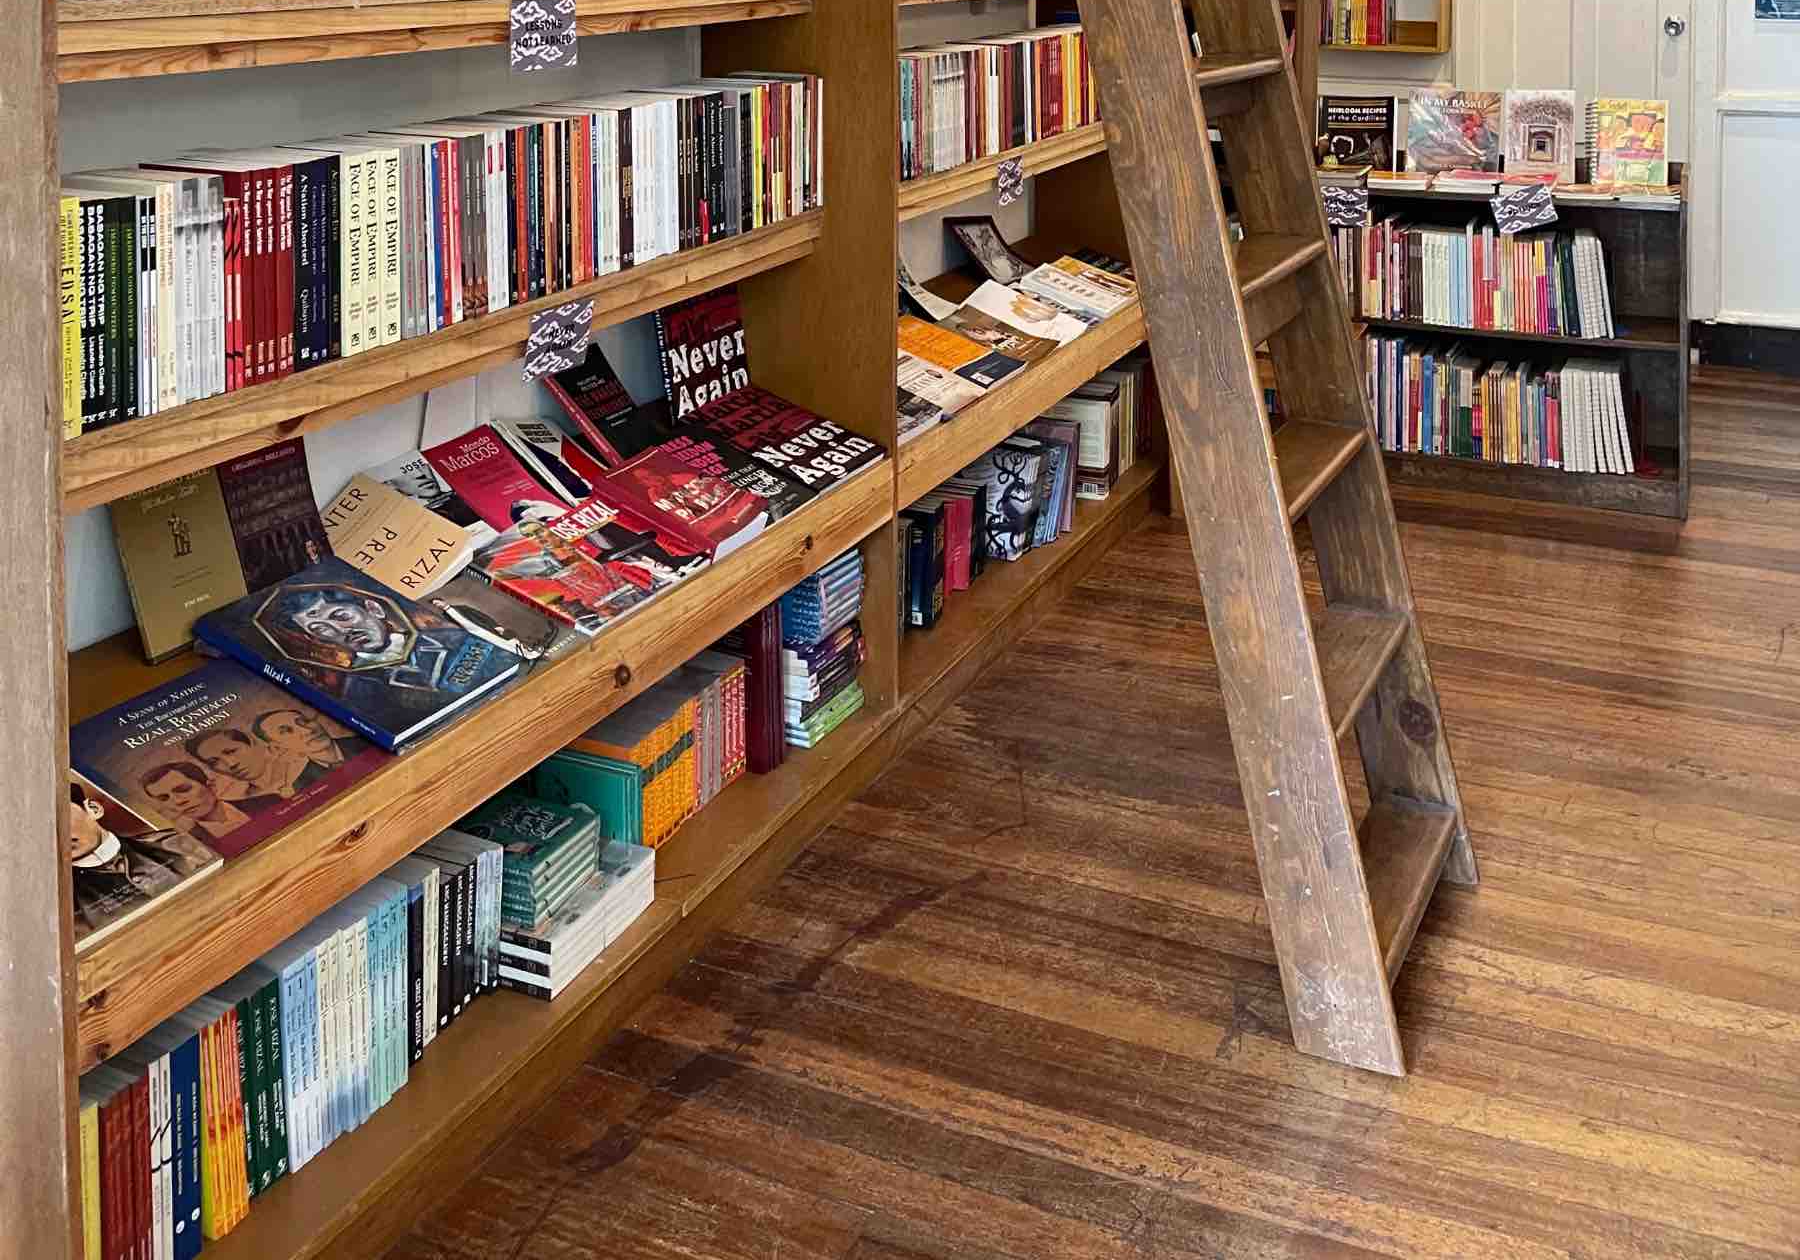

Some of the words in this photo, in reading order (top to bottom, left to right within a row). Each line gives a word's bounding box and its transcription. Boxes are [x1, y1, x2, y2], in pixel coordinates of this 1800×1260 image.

[525, 19, 562, 32] LESSONS
[349, 164, 361, 199] FACE
[366, 160, 377, 196] FACE
[385, 158, 398, 193] FACE
[301, 184, 309, 220] Nation
[351, 204, 360, 222] OF
[367, 199, 377, 218] OF
[386, 196, 396, 215] OF
[87, 206, 96, 275] BASAGAN
[96, 205, 105, 271] BASAGAN
[366, 223, 378, 281] EMPIRE
[385, 220, 398, 278] EMPIRE
[349, 228, 361, 286] EMPIRE
[61, 268, 74, 318] EDSA
[88, 276, 96, 297] NG
[97, 274, 105, 293] NG
[88, 298, 96, 328] TRIP
[97, 295, 105, 325] TRIP
[88, 336, 96, 368] Lisandro
[669, 329, 745, 384] Never
[98, 367, 106, 396] Claudio
[678, 363, 749, 421] Again
[438, 443, 500, 473] Marcos
[459, 434, 491, 452] Mondo
[752, 420, 846, 469] Never
[789, 436, 877, 486] Again
[550, 516, 579, 540] OSÉ
[579, 500, 619, 532] RIZAL
[400, 538, 457, 589] RIZAL
